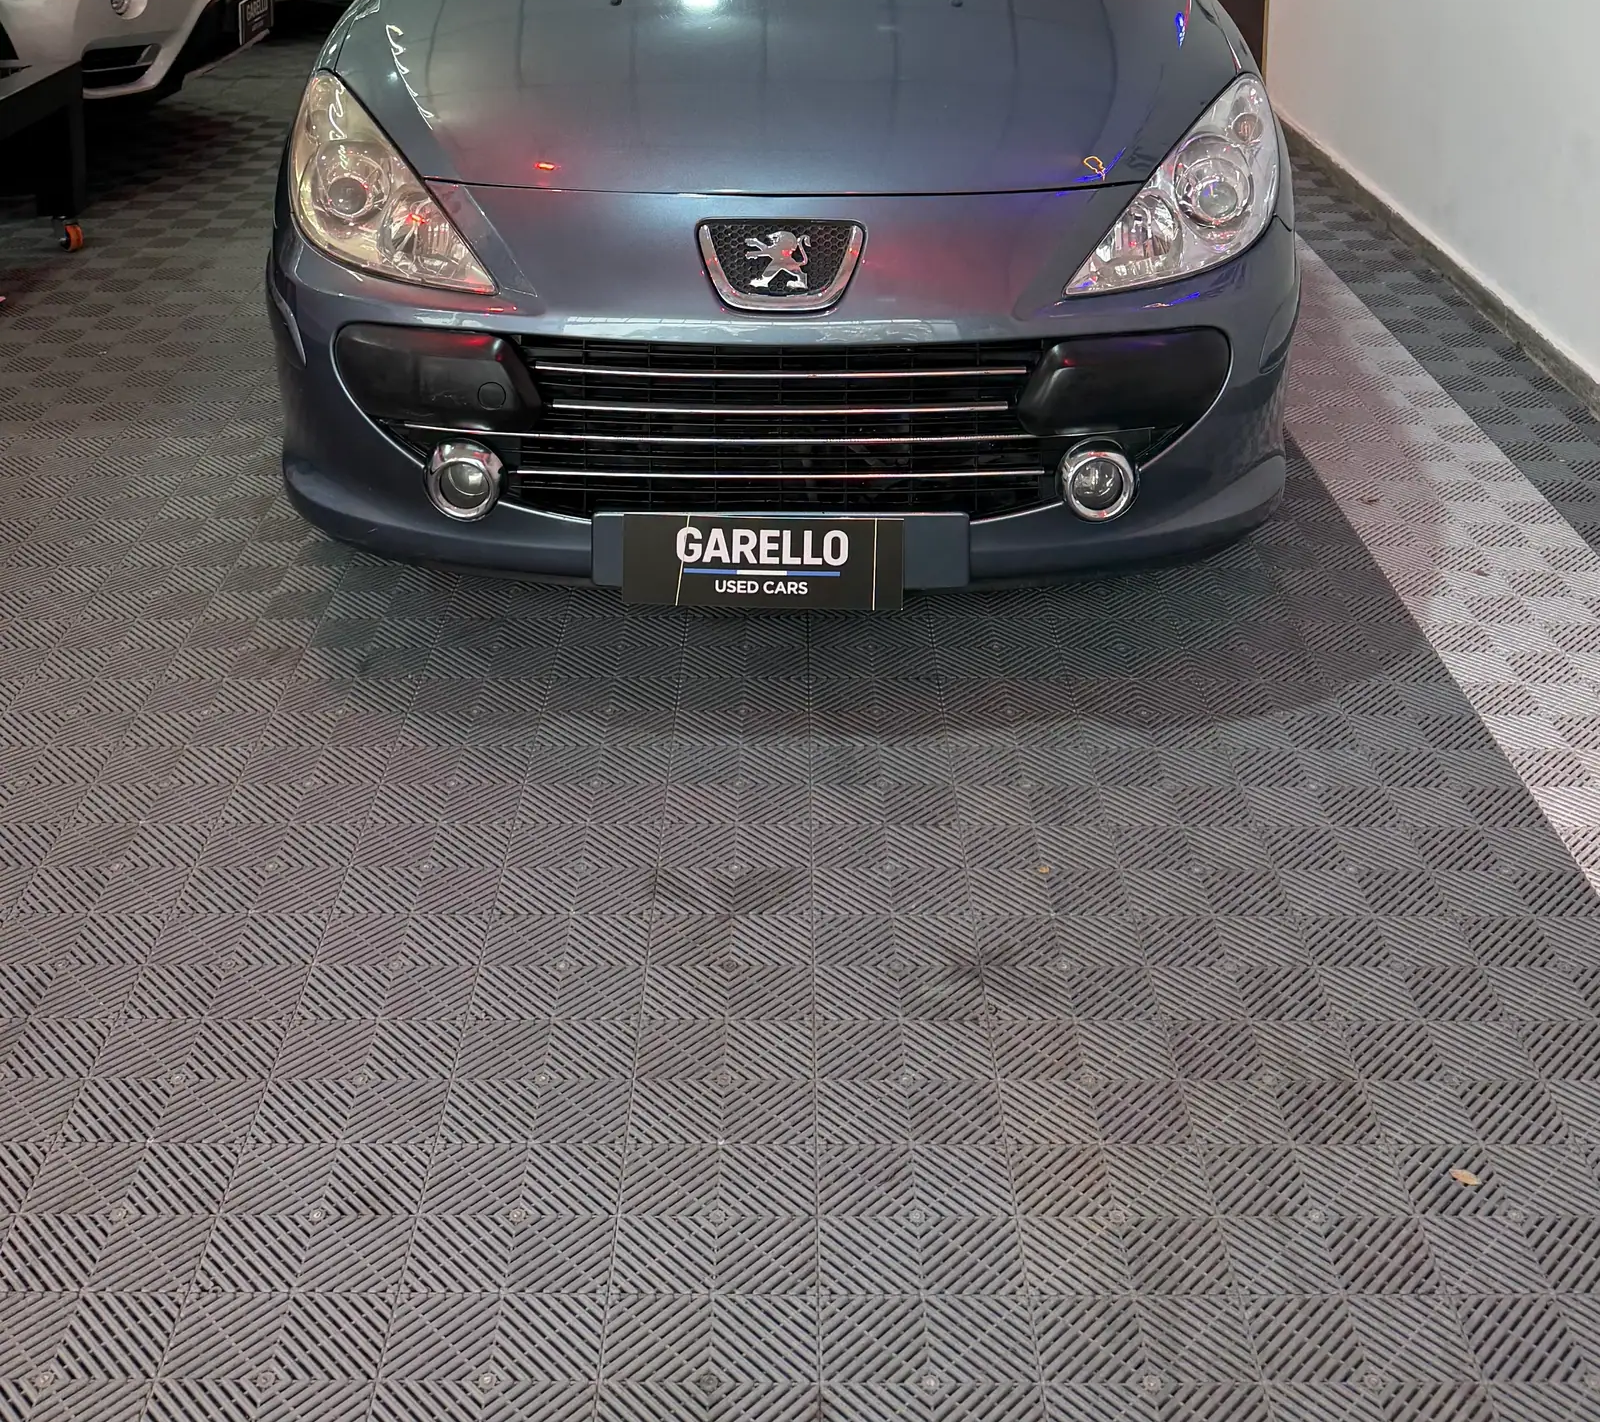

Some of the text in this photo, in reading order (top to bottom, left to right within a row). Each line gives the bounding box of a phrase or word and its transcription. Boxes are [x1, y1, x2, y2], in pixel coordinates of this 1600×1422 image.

[676, 526, 849, 567] GARELLO
[715, 579, 808, 595] USED CARS
